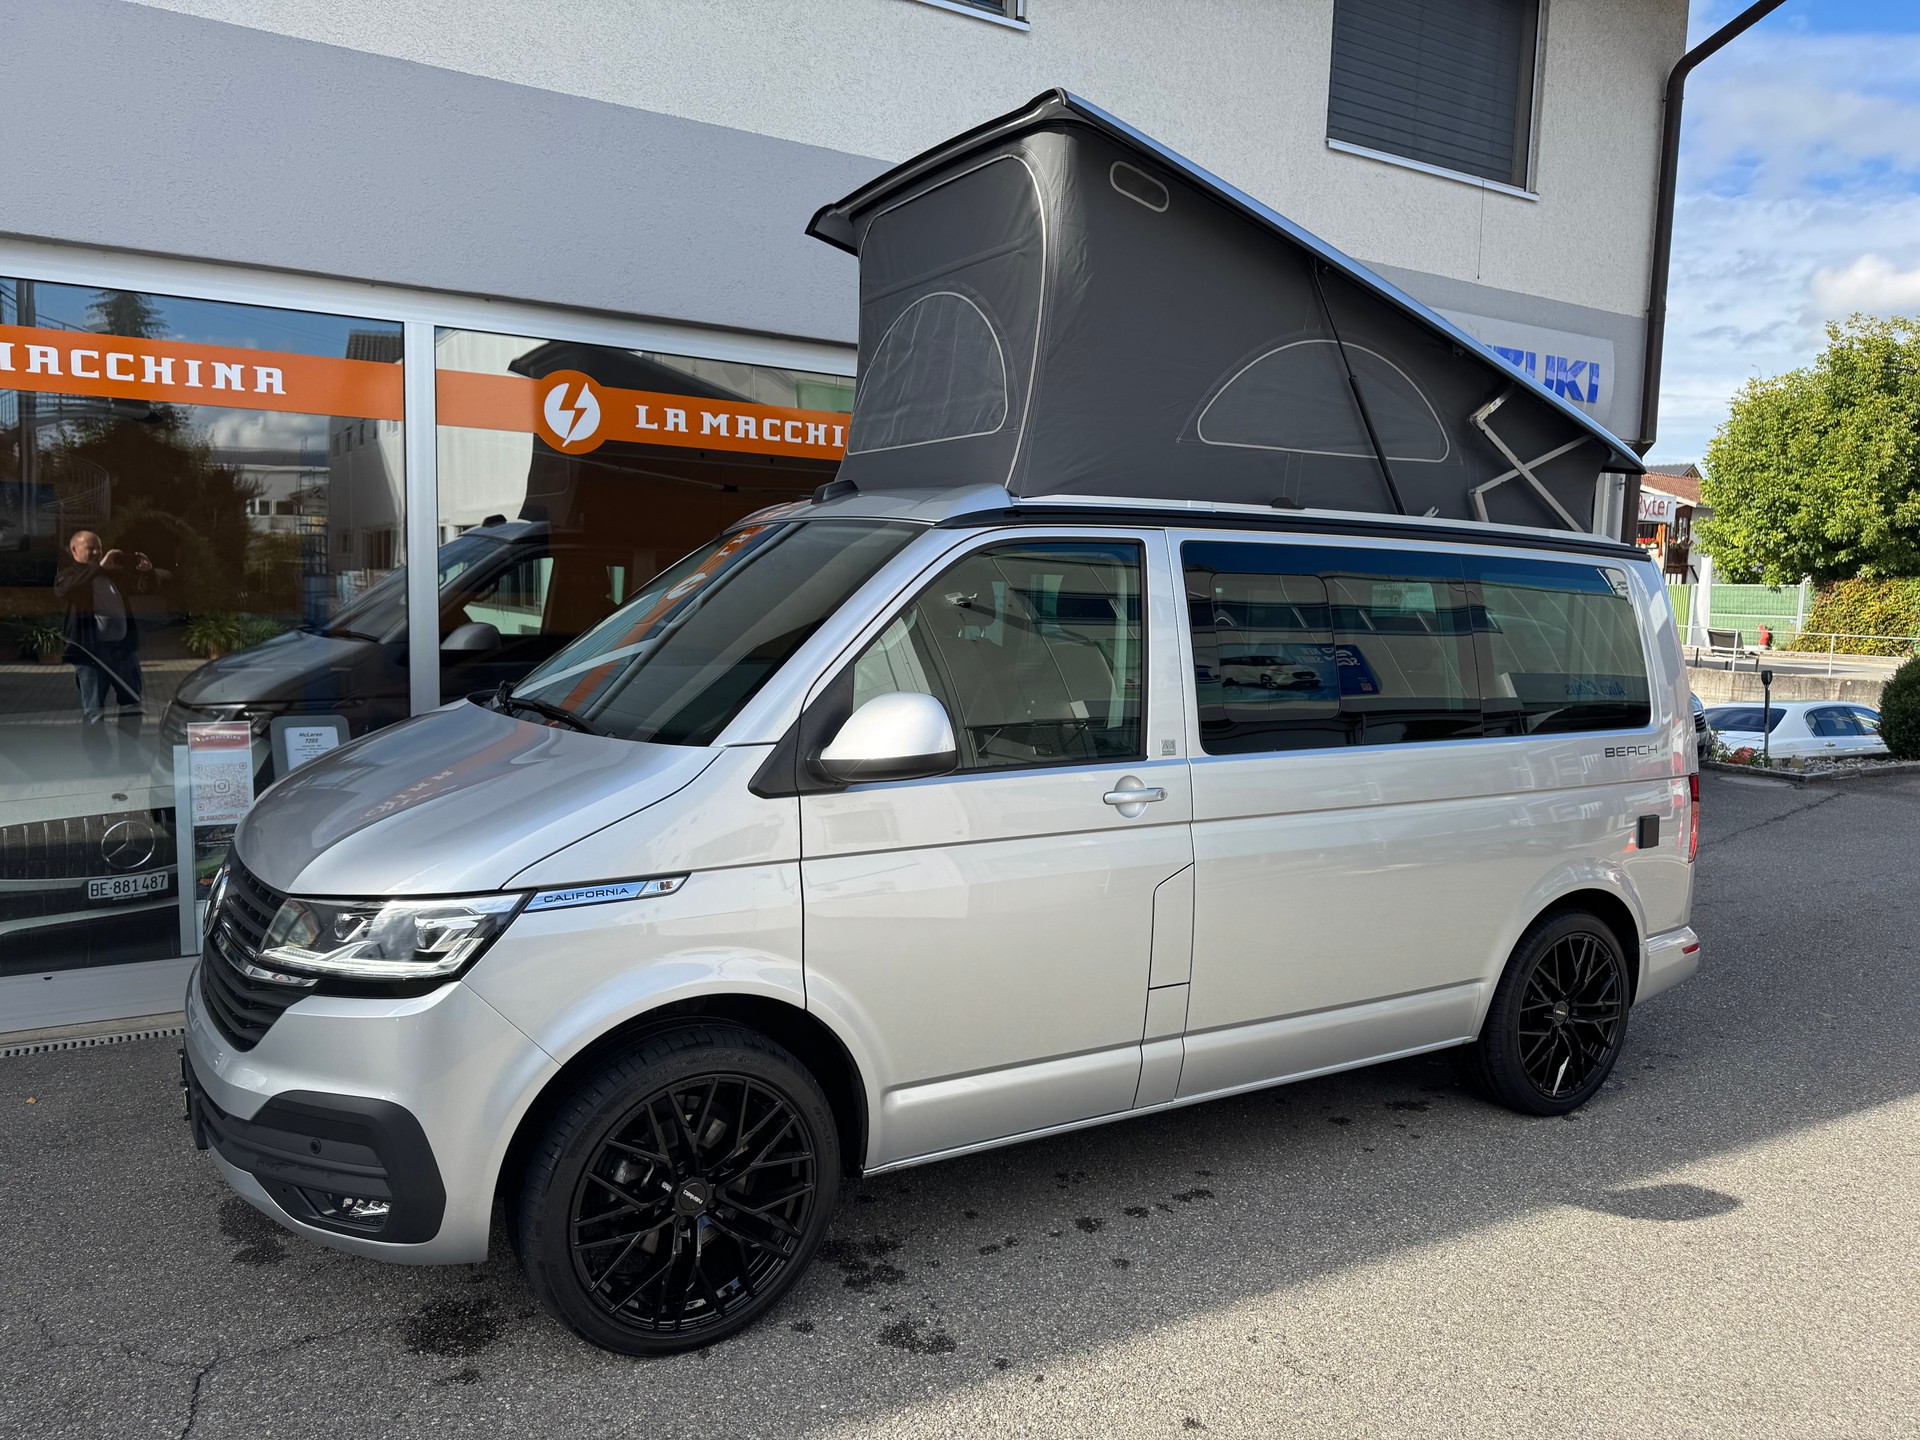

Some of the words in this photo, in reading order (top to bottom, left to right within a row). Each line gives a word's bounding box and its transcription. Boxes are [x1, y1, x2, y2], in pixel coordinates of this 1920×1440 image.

[635, 404, 689, 433] LA
[700, 411, 845, 448] MACCHI
[1604, 744, 1658, 758] BEACH
[543, 887, 629, 903] CALIFORNIA
